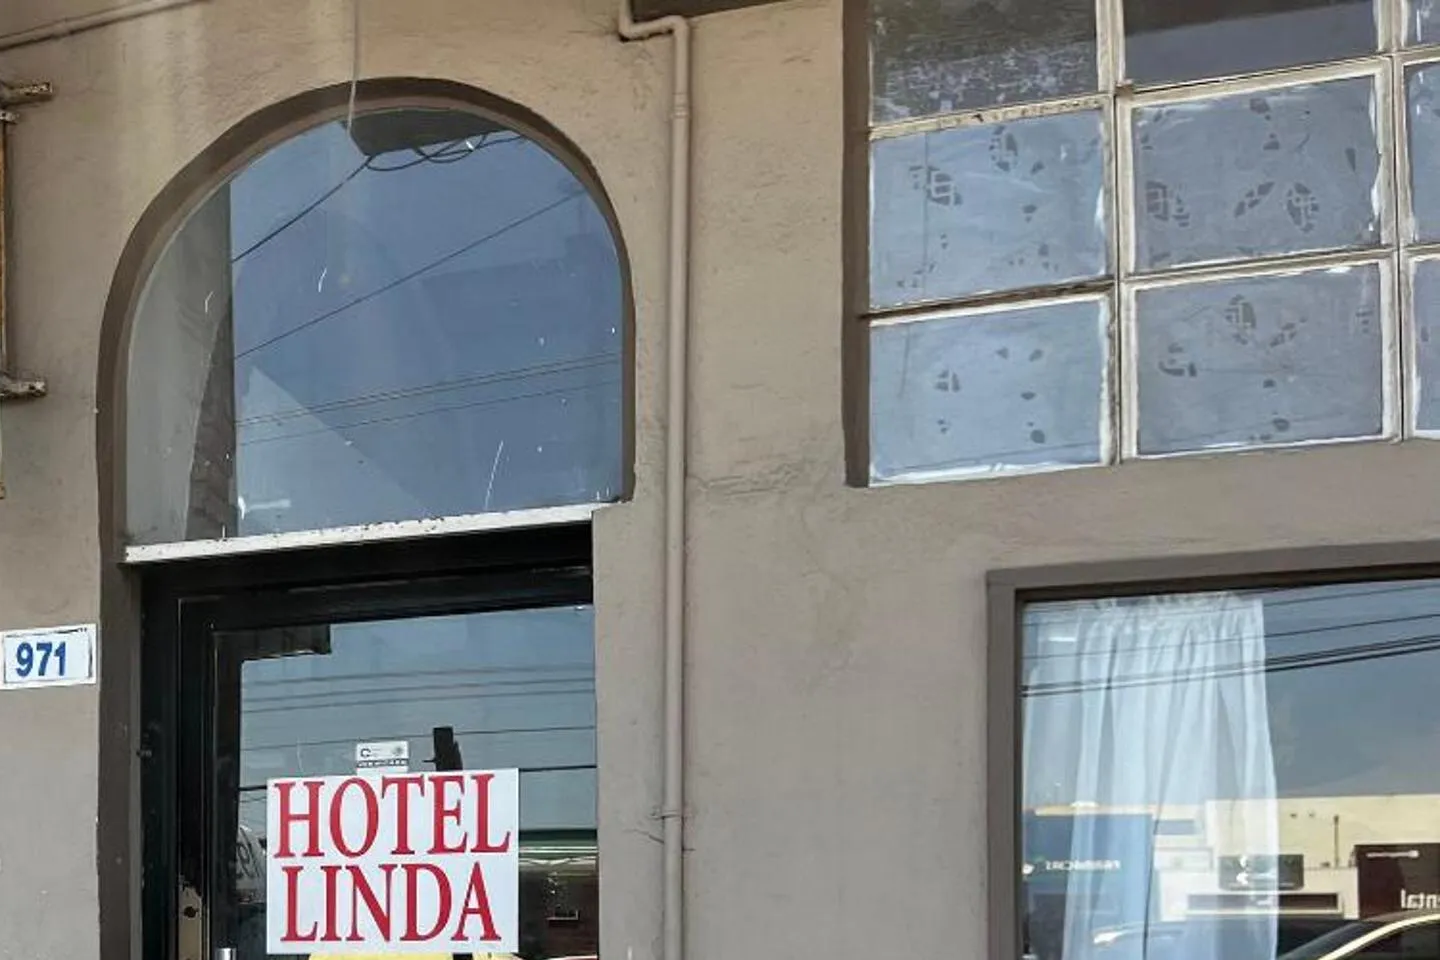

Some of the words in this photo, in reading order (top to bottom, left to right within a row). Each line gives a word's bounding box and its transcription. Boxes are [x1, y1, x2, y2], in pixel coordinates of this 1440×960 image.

[15, 640, 67, 678] 971
[273, 773, 511, 858] HOTEL
[280, 861, 502, 942] LINDA
